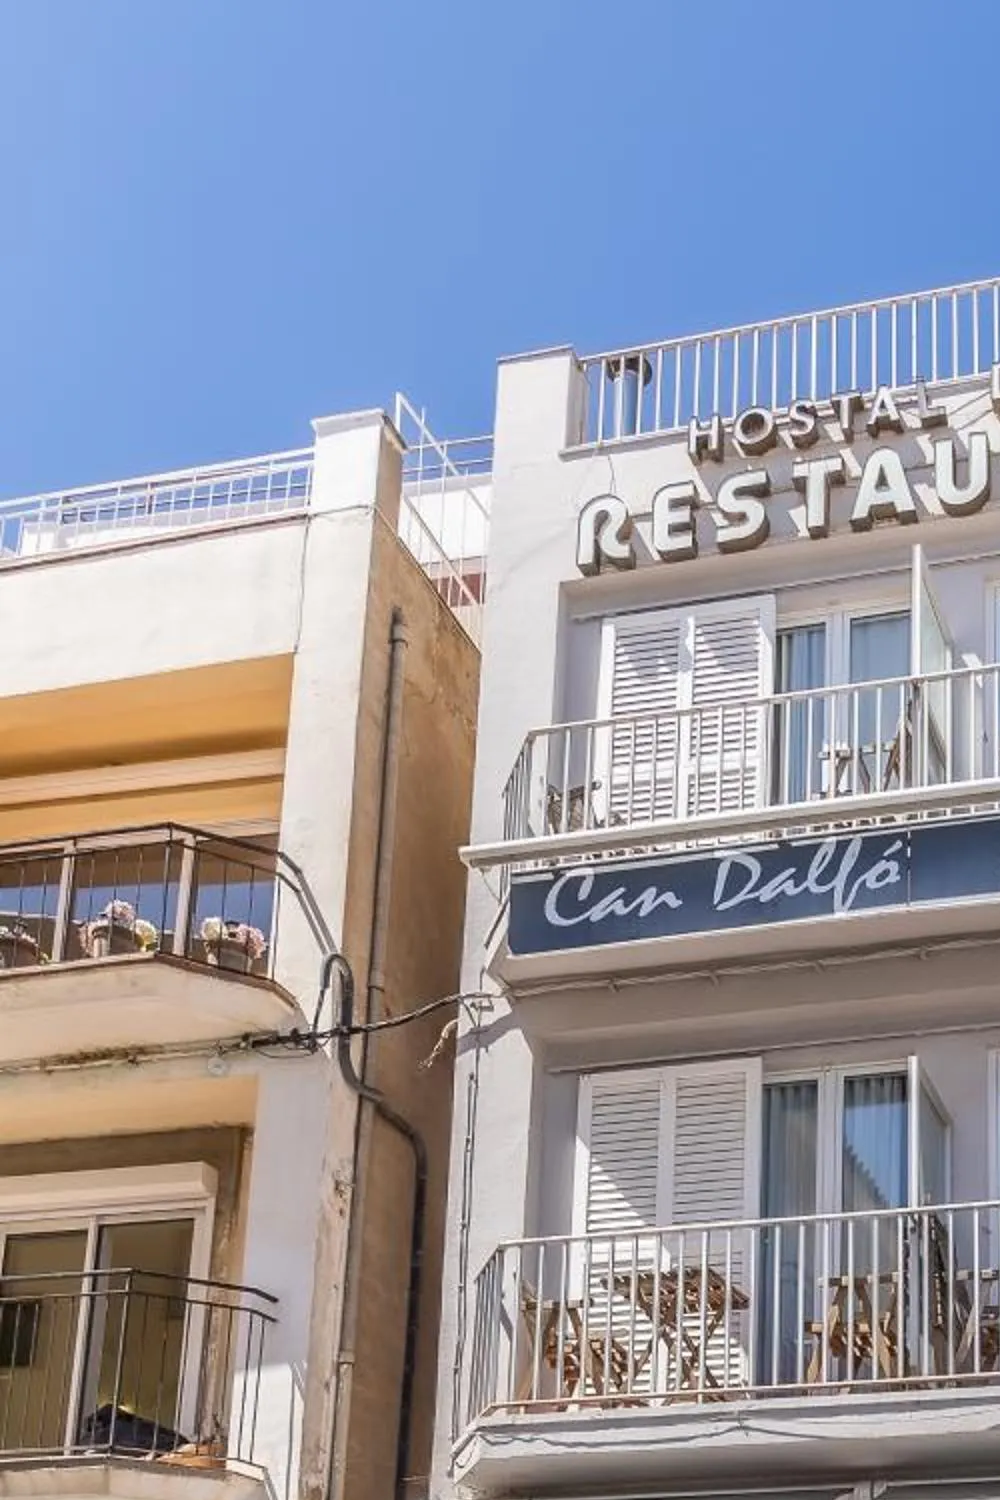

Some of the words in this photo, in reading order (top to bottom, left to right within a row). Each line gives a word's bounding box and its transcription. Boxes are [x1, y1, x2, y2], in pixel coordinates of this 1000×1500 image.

[688, 378, 948, 463] HOSTAL
[544, 868, 683, 927] Can
[713, 837, 902, 916] Dalfó
